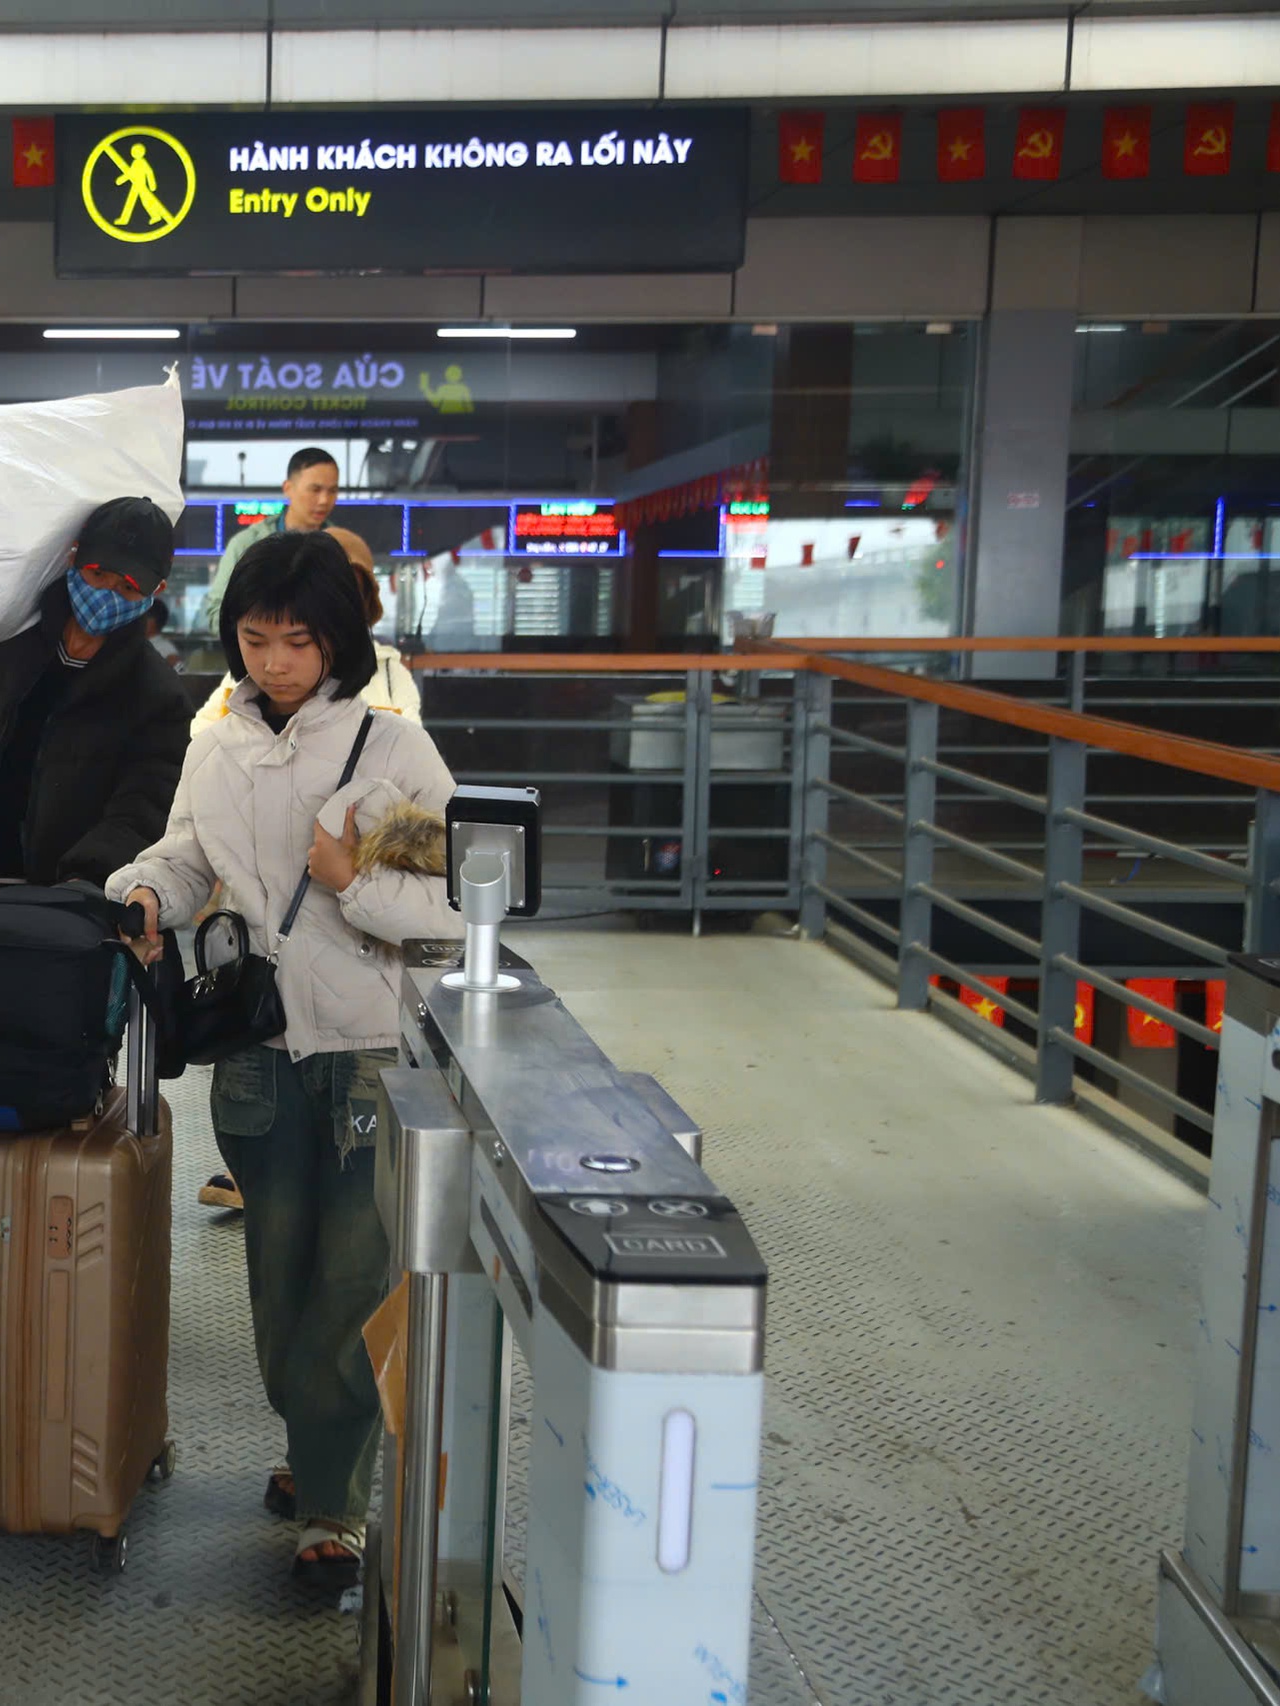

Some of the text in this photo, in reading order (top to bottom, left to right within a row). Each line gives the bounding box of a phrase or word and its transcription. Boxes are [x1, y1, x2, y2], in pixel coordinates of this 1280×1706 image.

[229, 130, 693, 171] HÀNH KHÁCH KHÔNG RA LỐI NÀY
[229, 186, 372, 218] Entry Only
[622, 1239, 707, 1252] CARD
